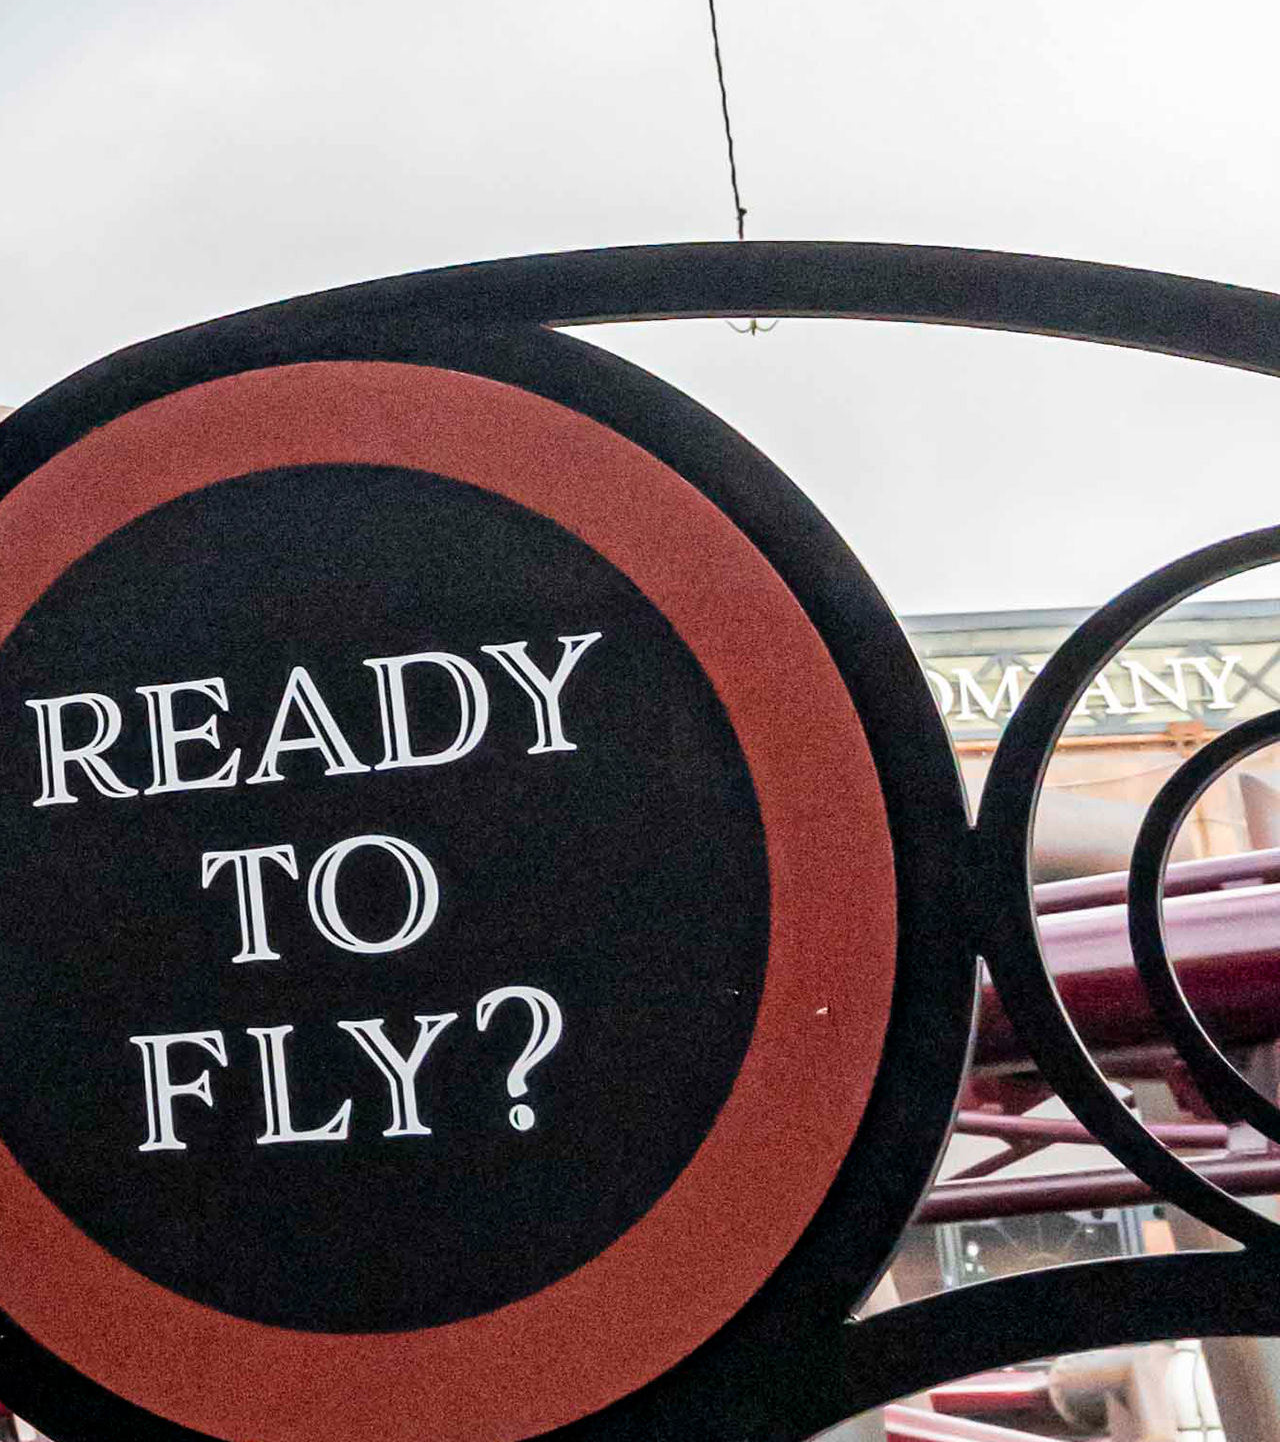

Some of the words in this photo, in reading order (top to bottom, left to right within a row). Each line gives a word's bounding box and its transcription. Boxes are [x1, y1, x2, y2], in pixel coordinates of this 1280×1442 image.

[25, 631, 603, 807] READY
[201, 834, 440, 963] TO
[129, 985, 564, 1152] FLY?
